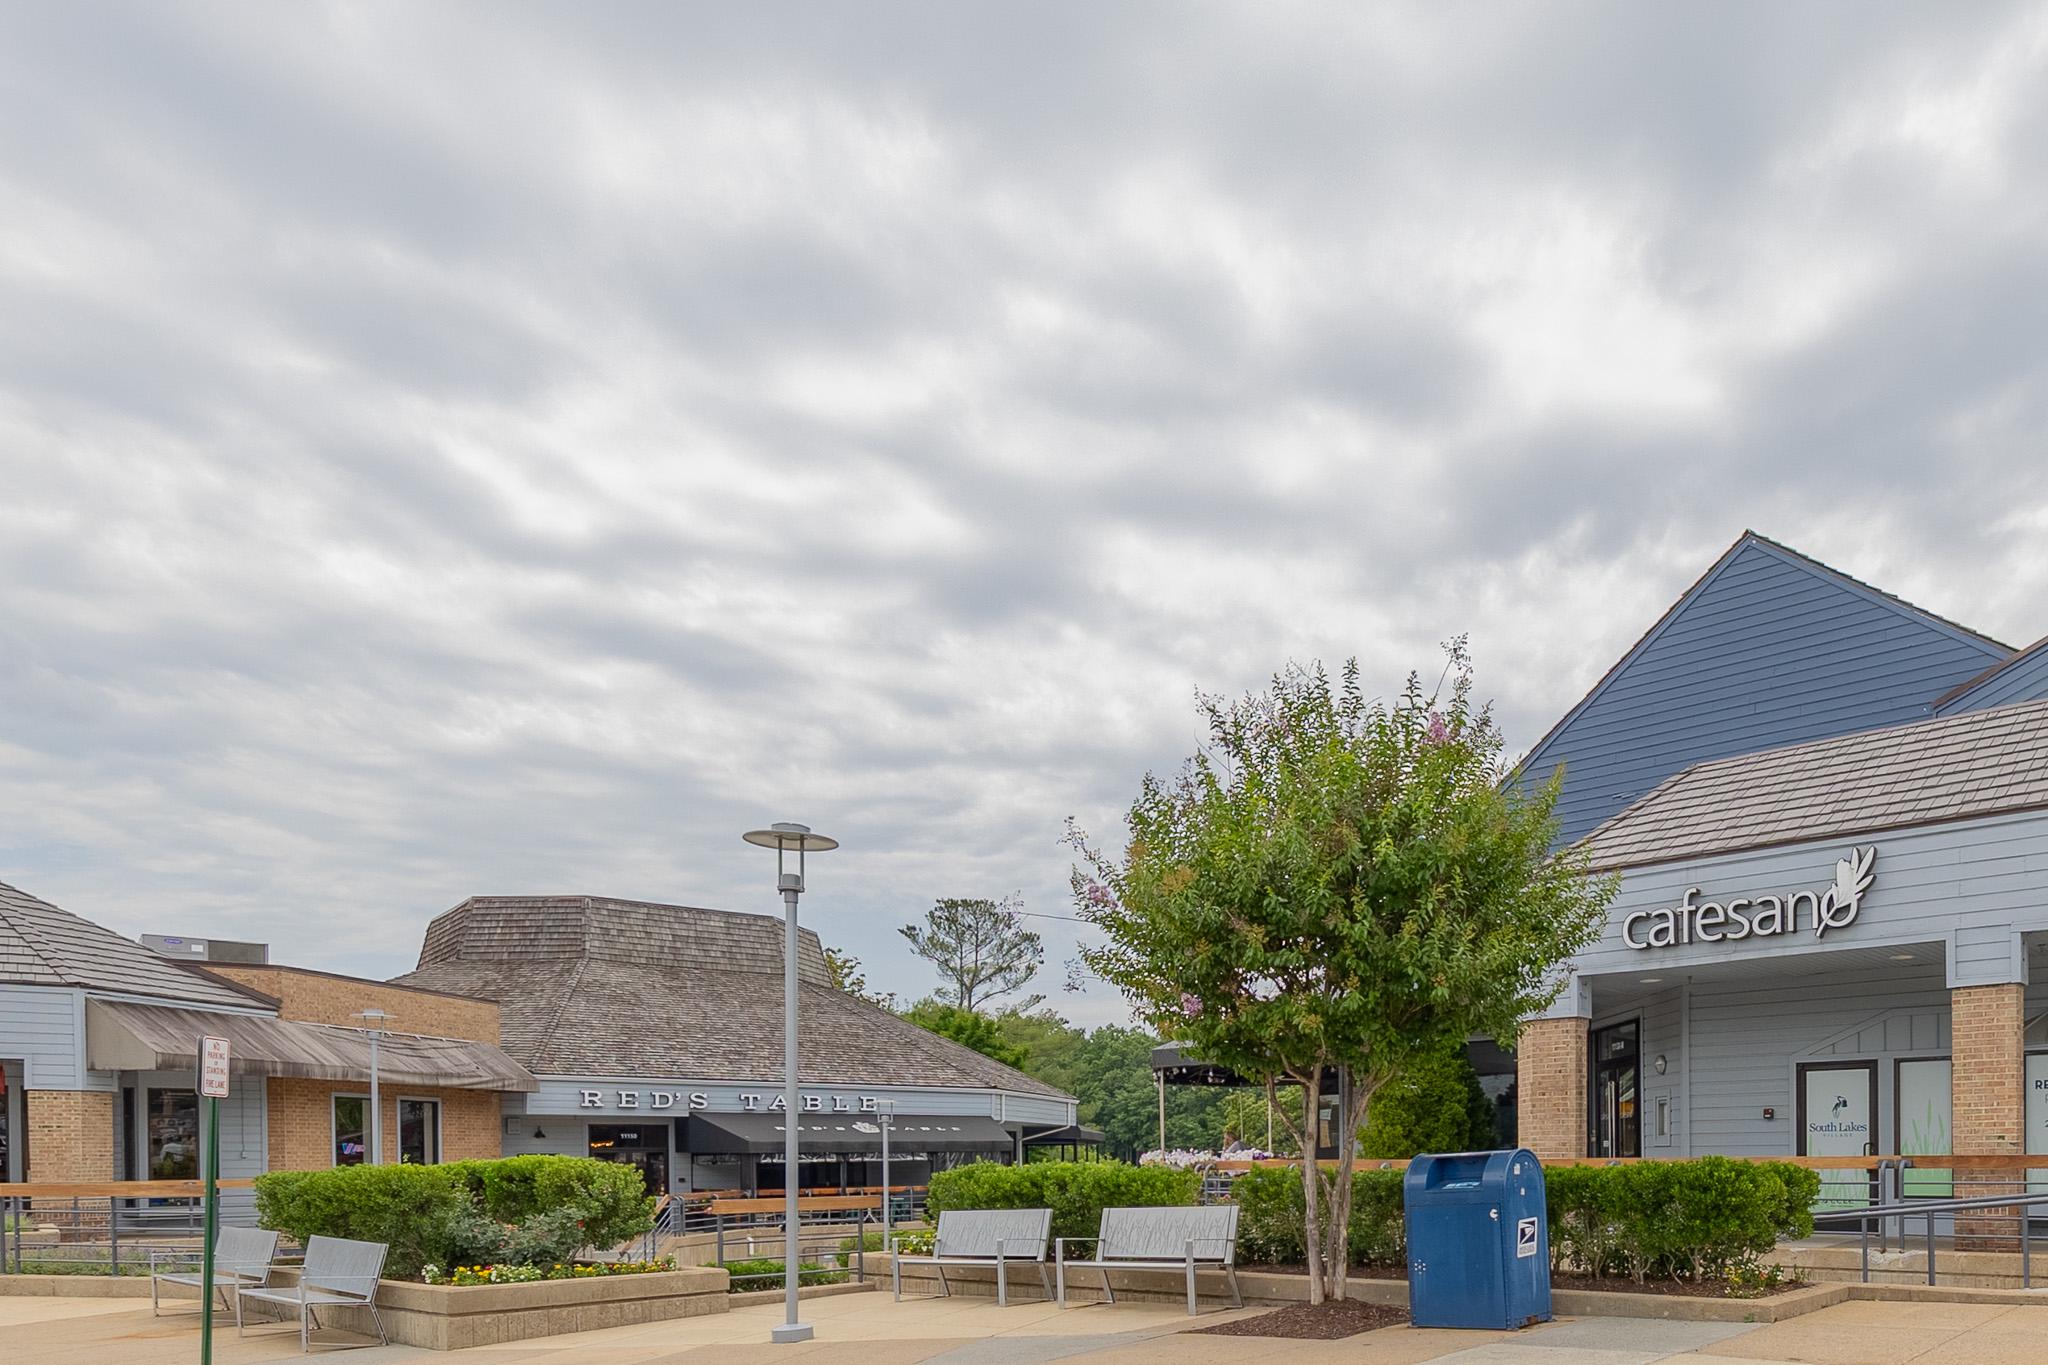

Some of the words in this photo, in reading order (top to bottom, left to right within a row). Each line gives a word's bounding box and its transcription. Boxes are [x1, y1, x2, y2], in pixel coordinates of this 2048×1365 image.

[1622, 884, 1860, 950] cafesano
[208, 1051, 225, 1060] PARKING
[579, 1090, 708, 1109] RED'S
[739, 1094, 877, 1112] TABLE
[1808, 1122, 1837, 1132] South
[1839, 1122, 1867, 1132] Lakes
